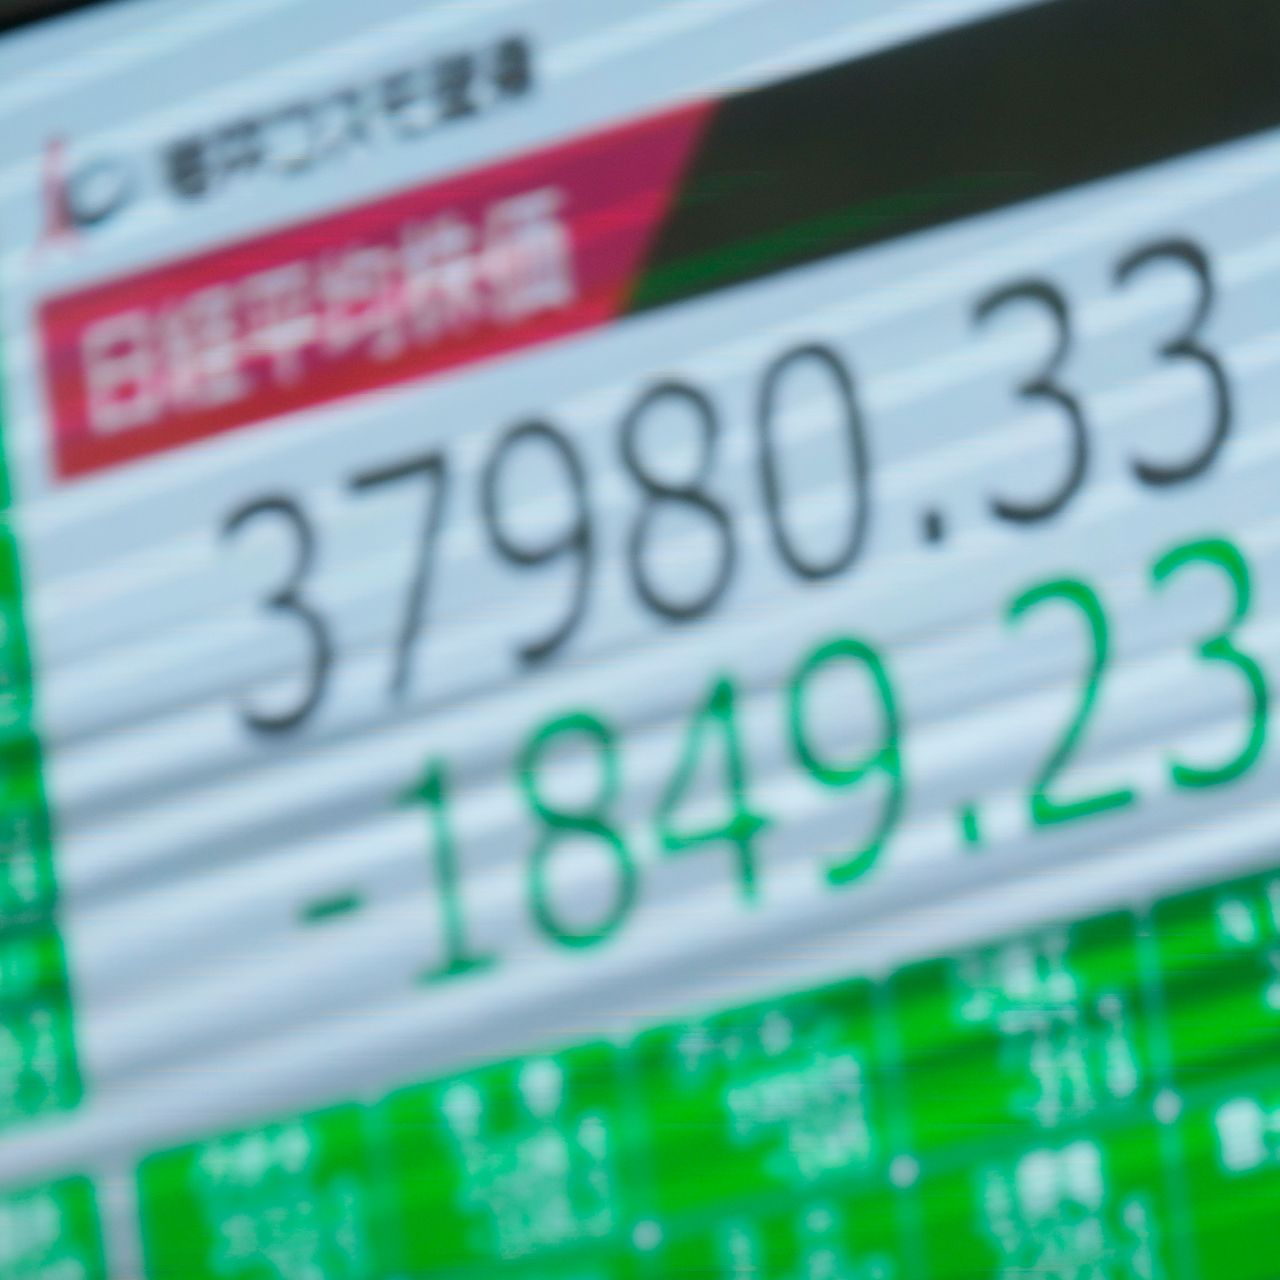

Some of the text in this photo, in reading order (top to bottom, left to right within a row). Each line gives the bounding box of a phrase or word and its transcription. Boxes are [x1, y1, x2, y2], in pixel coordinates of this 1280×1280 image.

[81, 184, 579, 435] 日経平均株価
[219, 236, 1234, 738] 37980.33
[298, 534, 1272, 985] -1849.23
